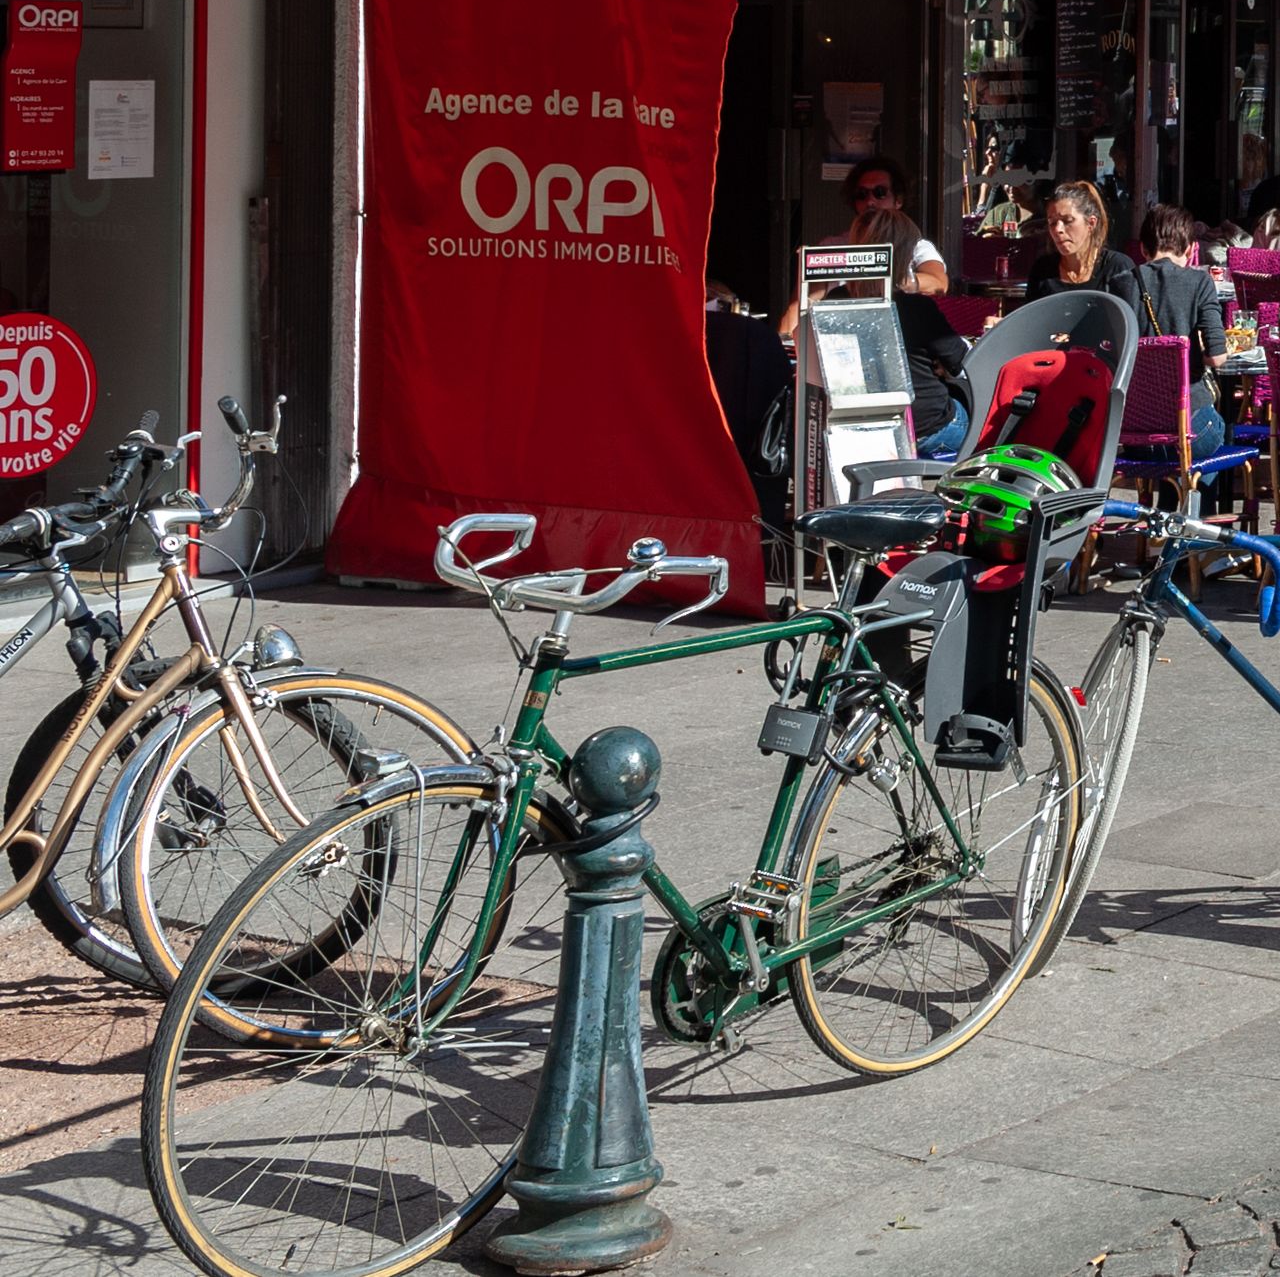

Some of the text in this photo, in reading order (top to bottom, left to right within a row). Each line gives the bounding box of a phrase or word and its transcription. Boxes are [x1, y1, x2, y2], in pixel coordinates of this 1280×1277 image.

[18, 4, 79, 27] ORPI
[424, 86, 533, 121] Agence
[544, 88, 580, 117] de
[591, 90, 624, 119] la
[459, 145, 666, 238] ORPI
[427, 236, 548, 259] SOLUTIONS
[0, 345, 57, 409] 50
[1, 422, 82, 474] votre vie
